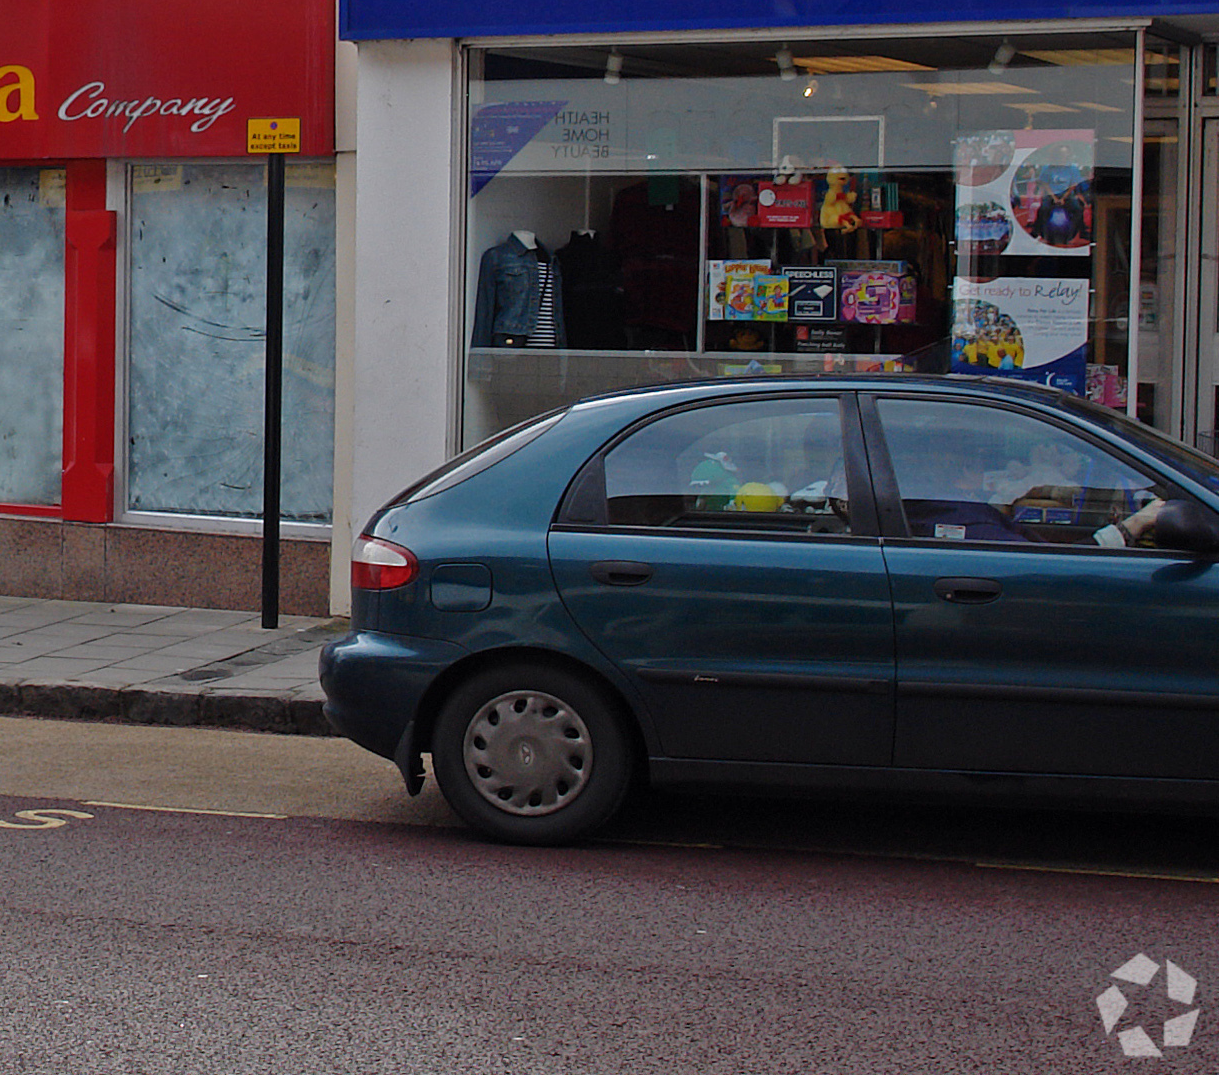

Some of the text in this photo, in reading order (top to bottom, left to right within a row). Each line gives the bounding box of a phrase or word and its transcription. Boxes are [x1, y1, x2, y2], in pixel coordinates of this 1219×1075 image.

[57, 81, 236, 134] Company
[959, 285, 980, 297] Get
[983, 285, 1015, 302] ready
[1019, 285, 1031, 298] to
